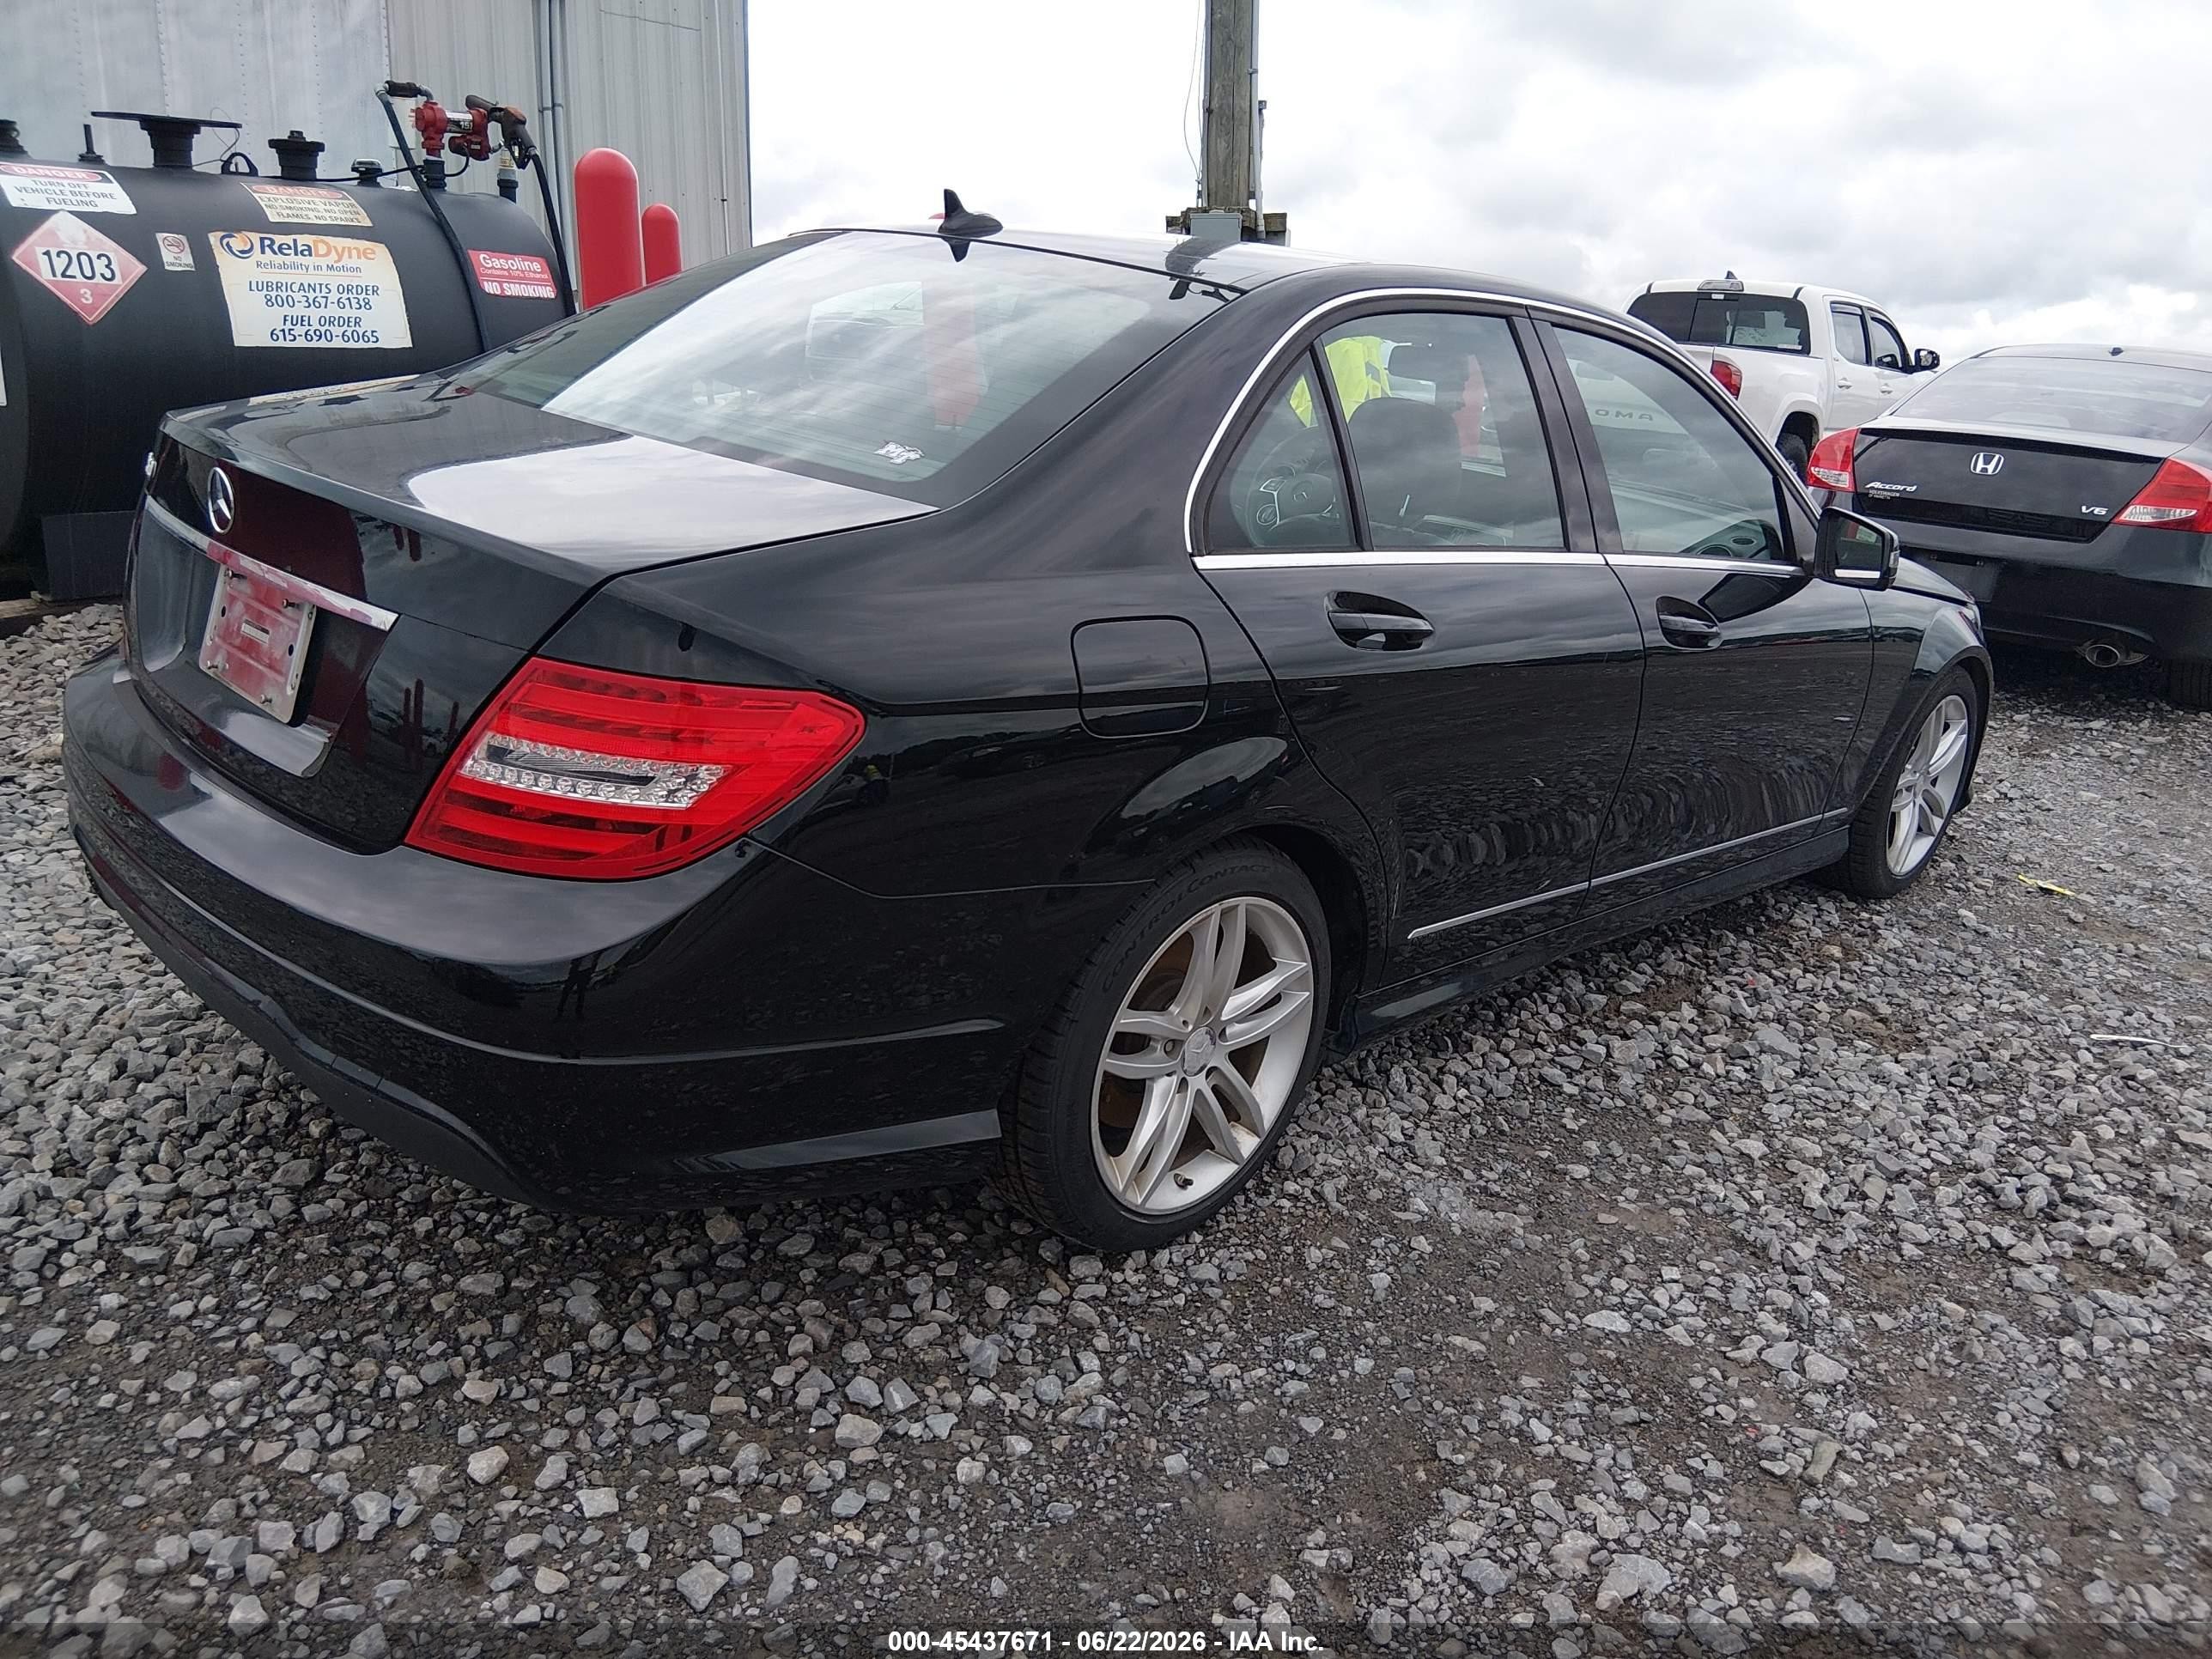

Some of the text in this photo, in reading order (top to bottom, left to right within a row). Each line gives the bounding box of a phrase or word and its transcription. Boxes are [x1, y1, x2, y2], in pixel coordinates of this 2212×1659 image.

[12, 165, 90, 179] DANGER
[31, 179, 66, 188] TURN
[15, 185, 117, 200] VEHICLE BEFORE
[266, 185, 330, 198] DANGER
[46, 197, 98, 208] FUELING
[259, 196, 358, 210] EXPLOSIVE VAPOR
[258, 236, 378, 264] RelaDyne
[41, 249, 117, 283] 1203
[256, 260, 362, 274] Reliability in Motion
[479, 253, 542, 272] Gasoline
[480, 267, 509, 276] Contains
[248, 280, 380, 296] LUBRICANTS ORDER
[483, 281, 556, 299] NO SMOKING
[80, 289, 94, 305] 3
[264, 294, 373, 311] 800-367-6138
[283, 314, 362, 328] FUEL ORDER
[270, 328, 380, 343] 615-690-6065
[1864, 481, 1917, 492] Accord
[2081, 505, 2109, 515] V6
